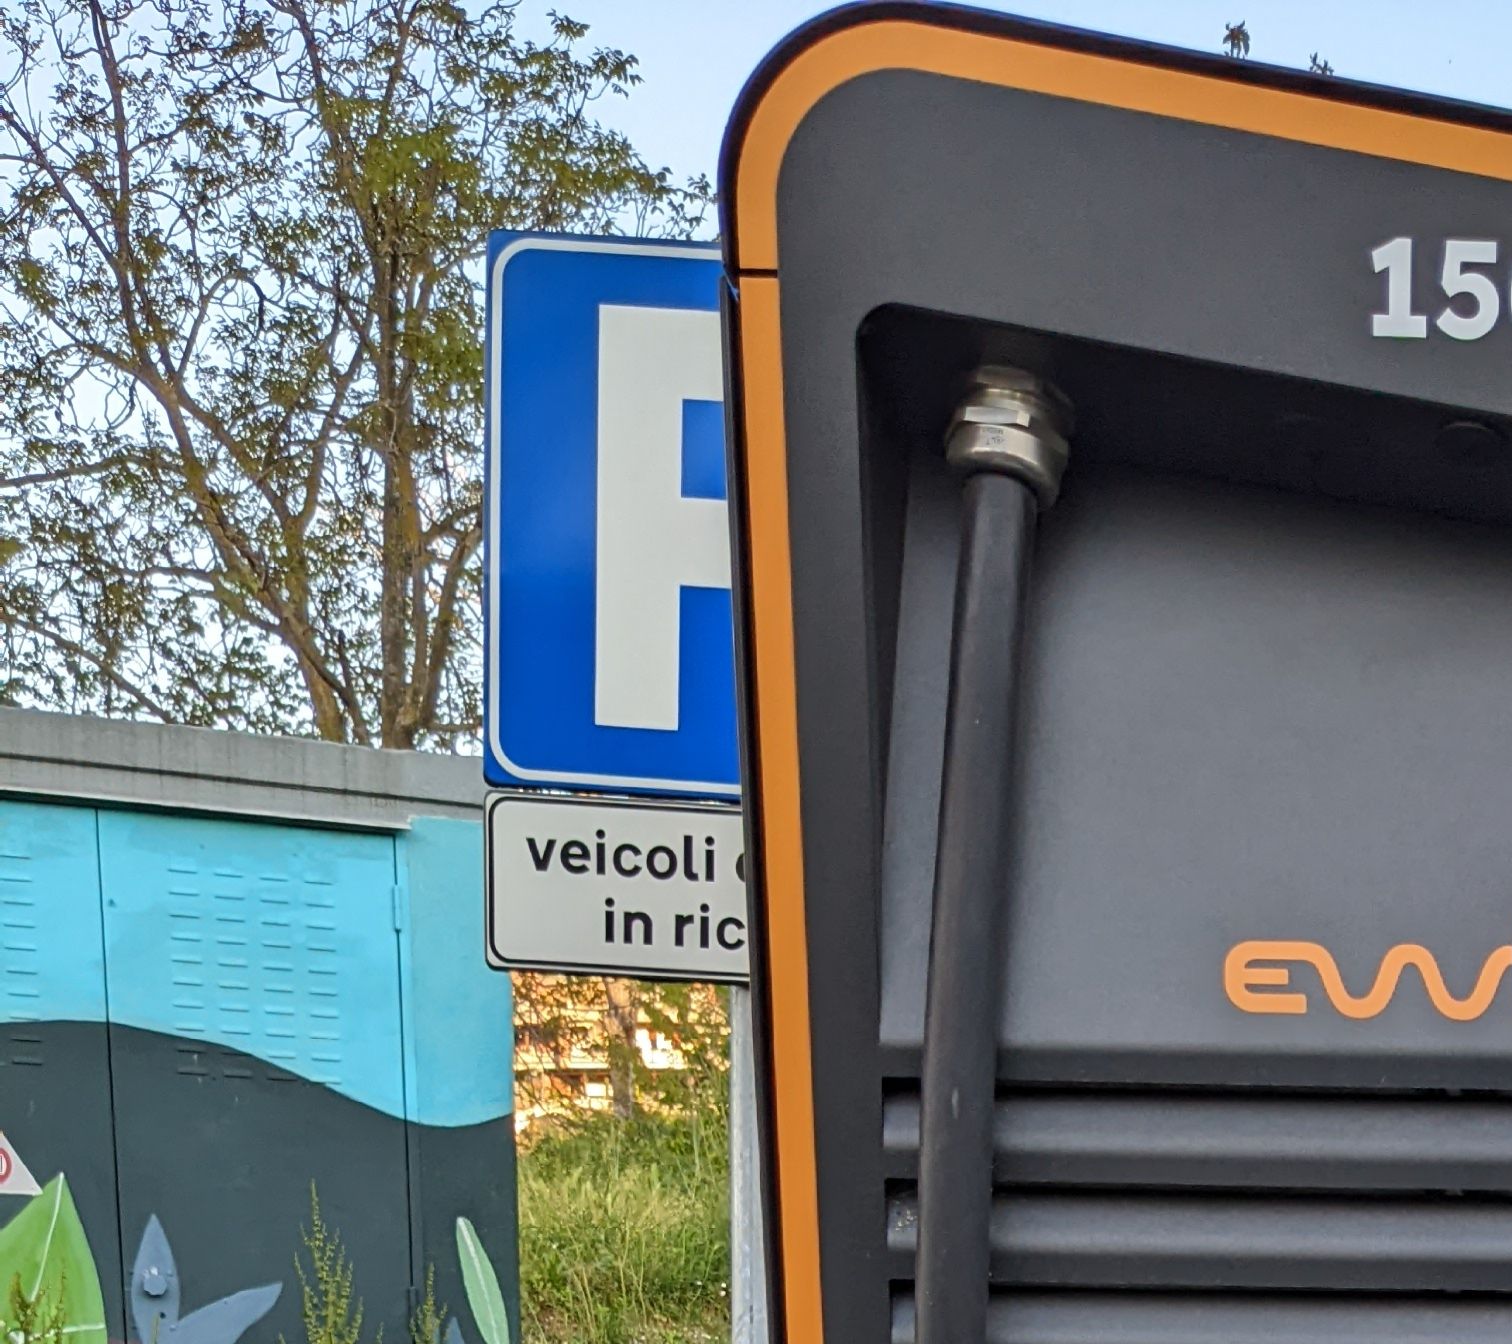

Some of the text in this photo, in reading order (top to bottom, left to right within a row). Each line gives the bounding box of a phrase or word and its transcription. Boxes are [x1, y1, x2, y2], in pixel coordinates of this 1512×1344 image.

[525, 828, 716, 883] veicoli
[604, 897, 746, 951] in ric
